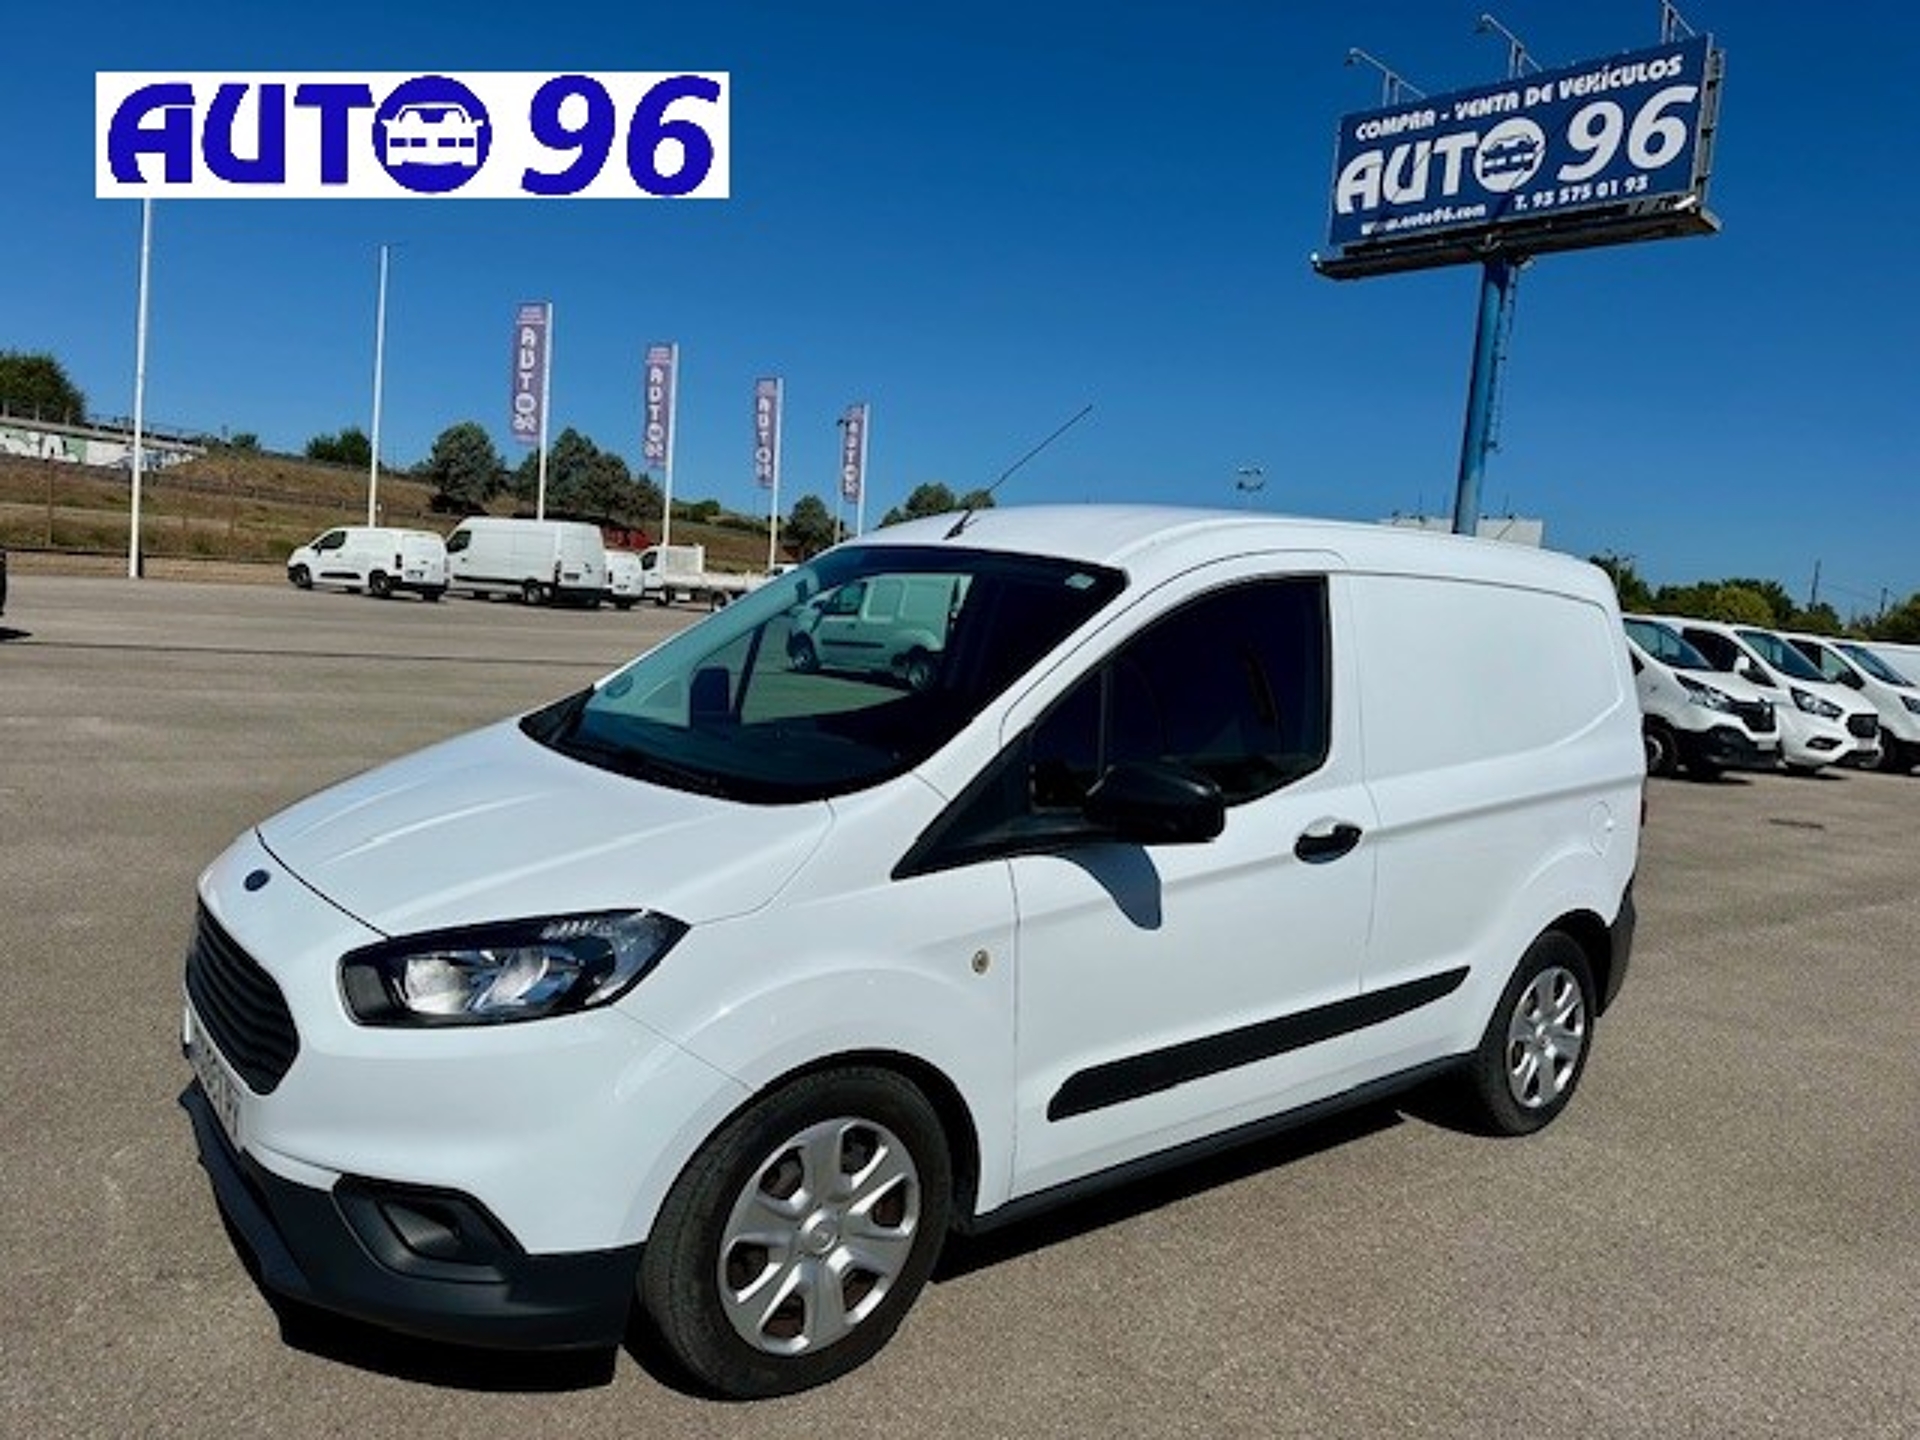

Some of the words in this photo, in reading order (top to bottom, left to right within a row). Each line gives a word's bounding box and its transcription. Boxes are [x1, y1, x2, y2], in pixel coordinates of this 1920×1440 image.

[1355, 109, 1435, 141] COMPRA
[1454, 92, 1520, 120] VENTA
[1524, 83, 1553, 107] DE
[1336, 116, 1546, 214] AUTO
[1557, 85, 1698, 182] 96
[1596, 179, 1618, 198] 01
[515, 326, 537, 413] AUTO
[647, 367, 664, 440] AUTO
